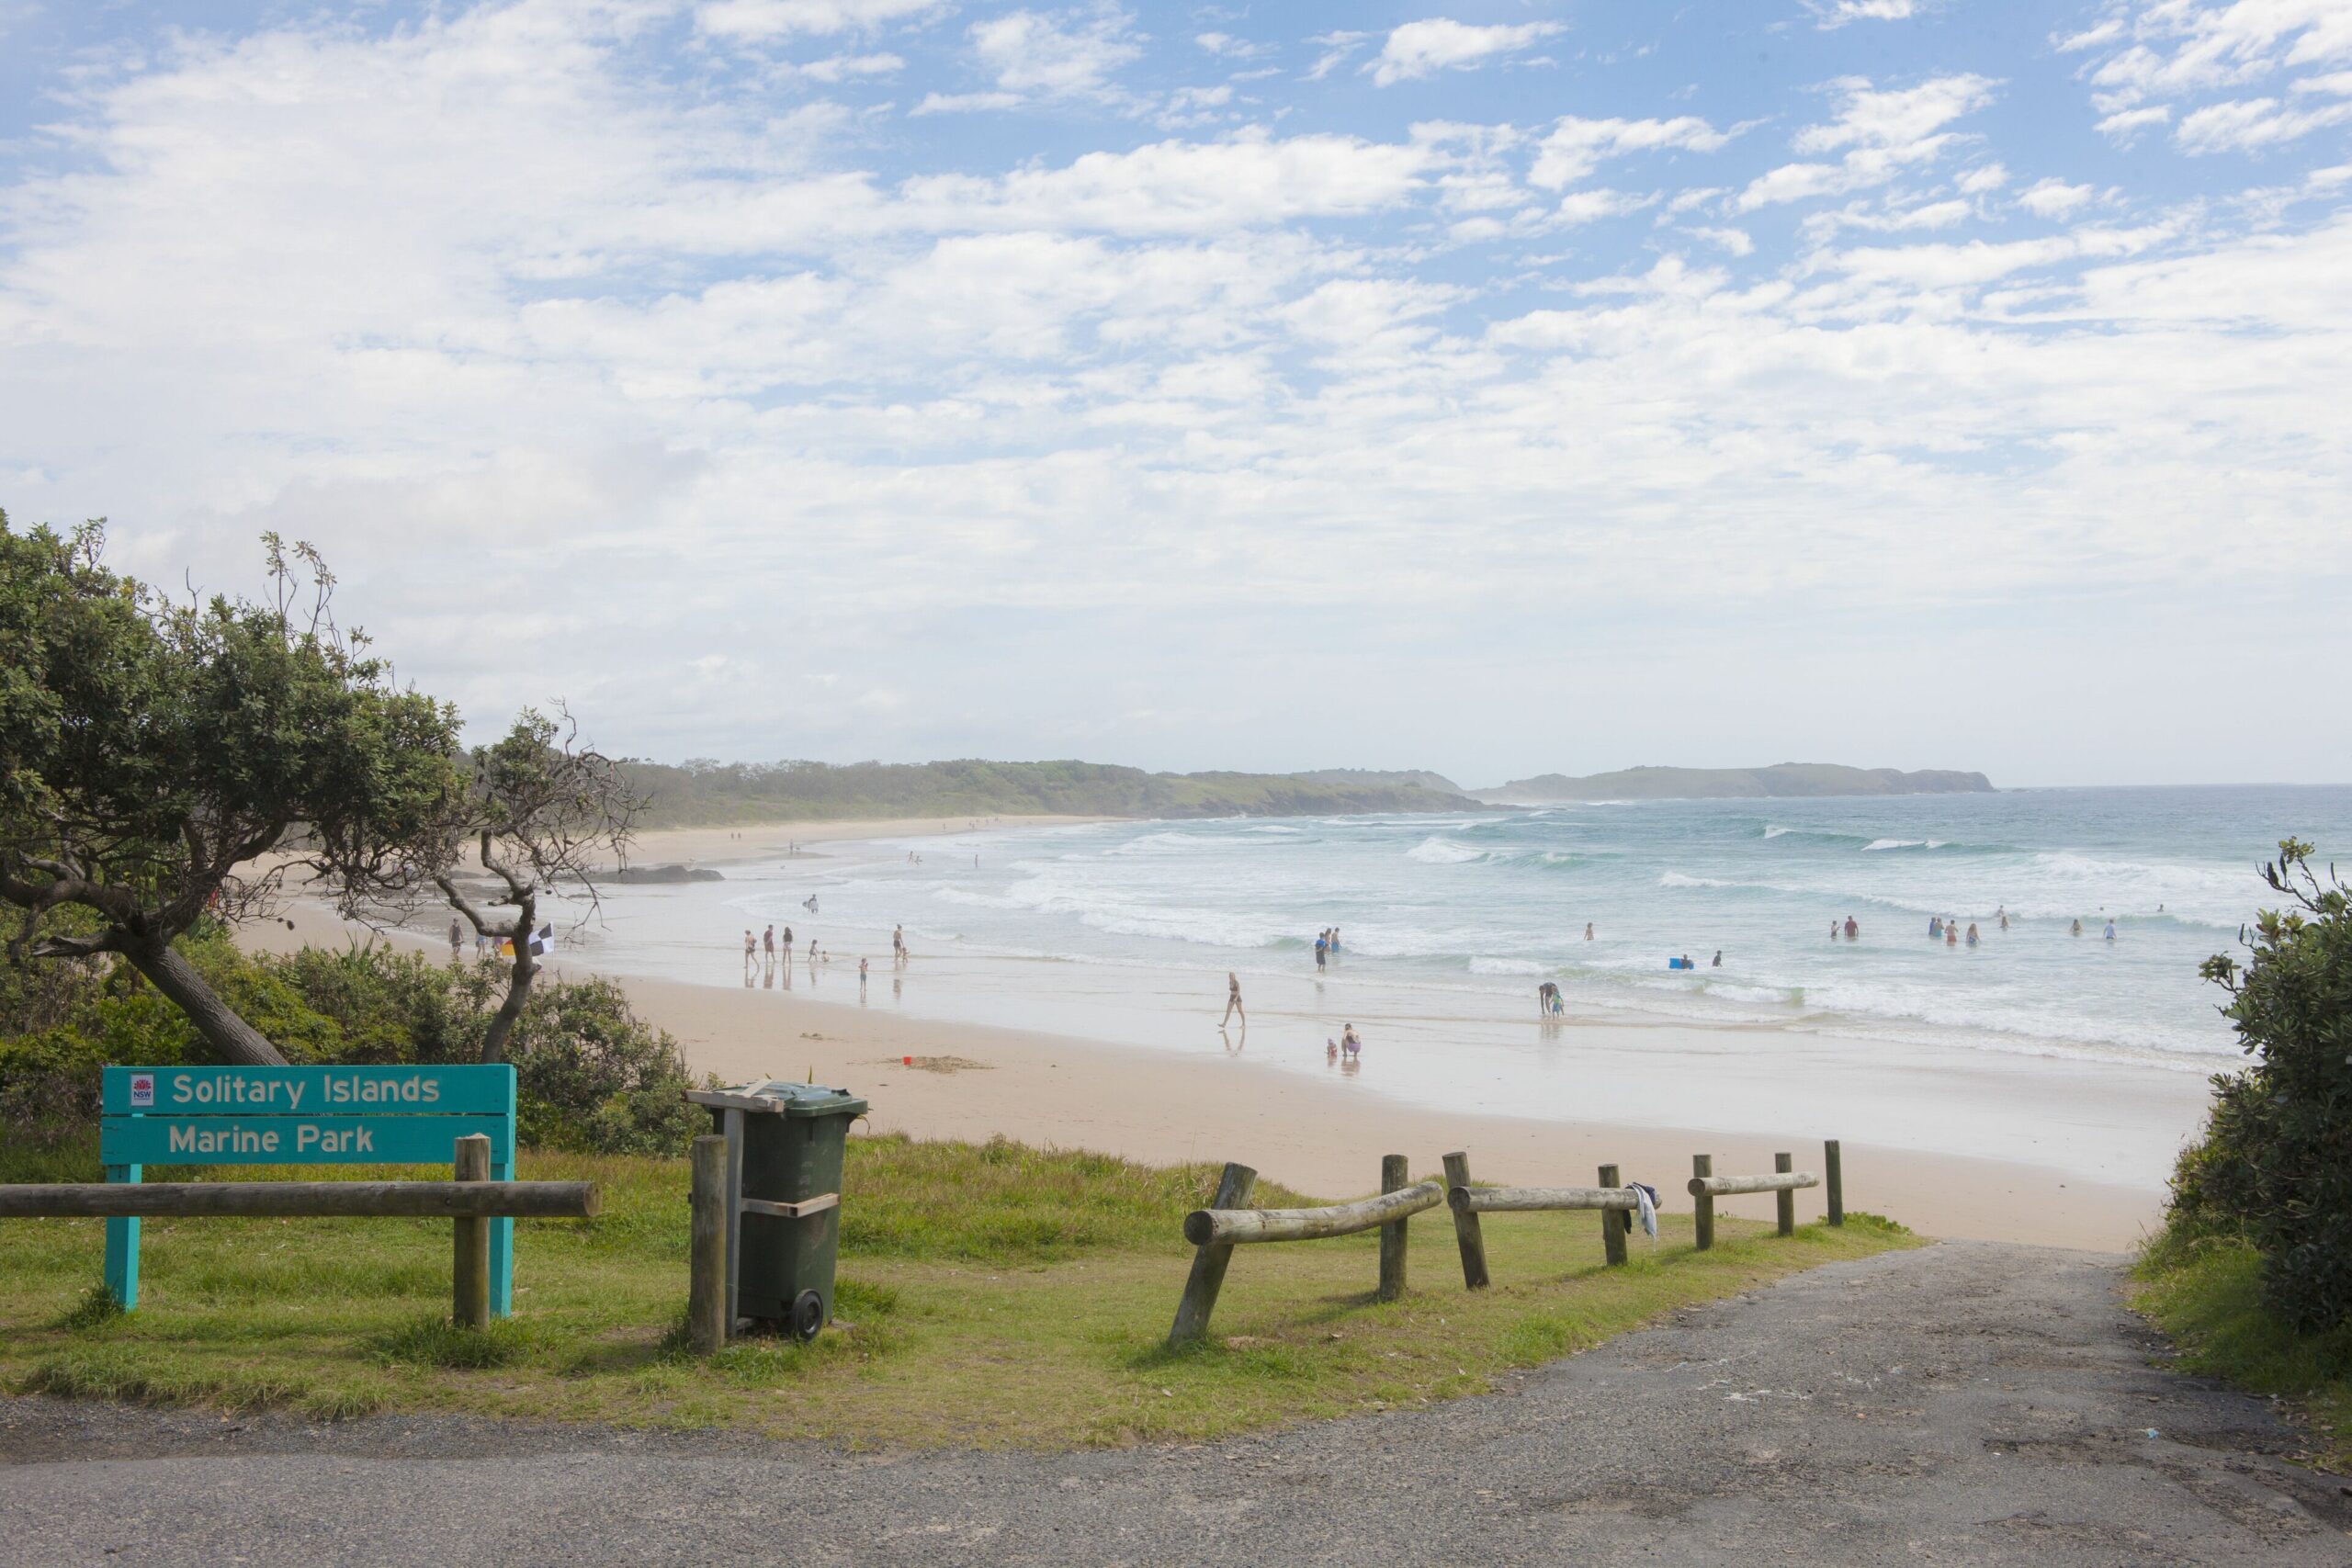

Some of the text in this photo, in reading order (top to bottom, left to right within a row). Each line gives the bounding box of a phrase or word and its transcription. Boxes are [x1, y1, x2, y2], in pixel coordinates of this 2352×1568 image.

[173, 1075, 440, 1110] Solitary Islands
[169, 1125, 374, 1152] Marine Park
